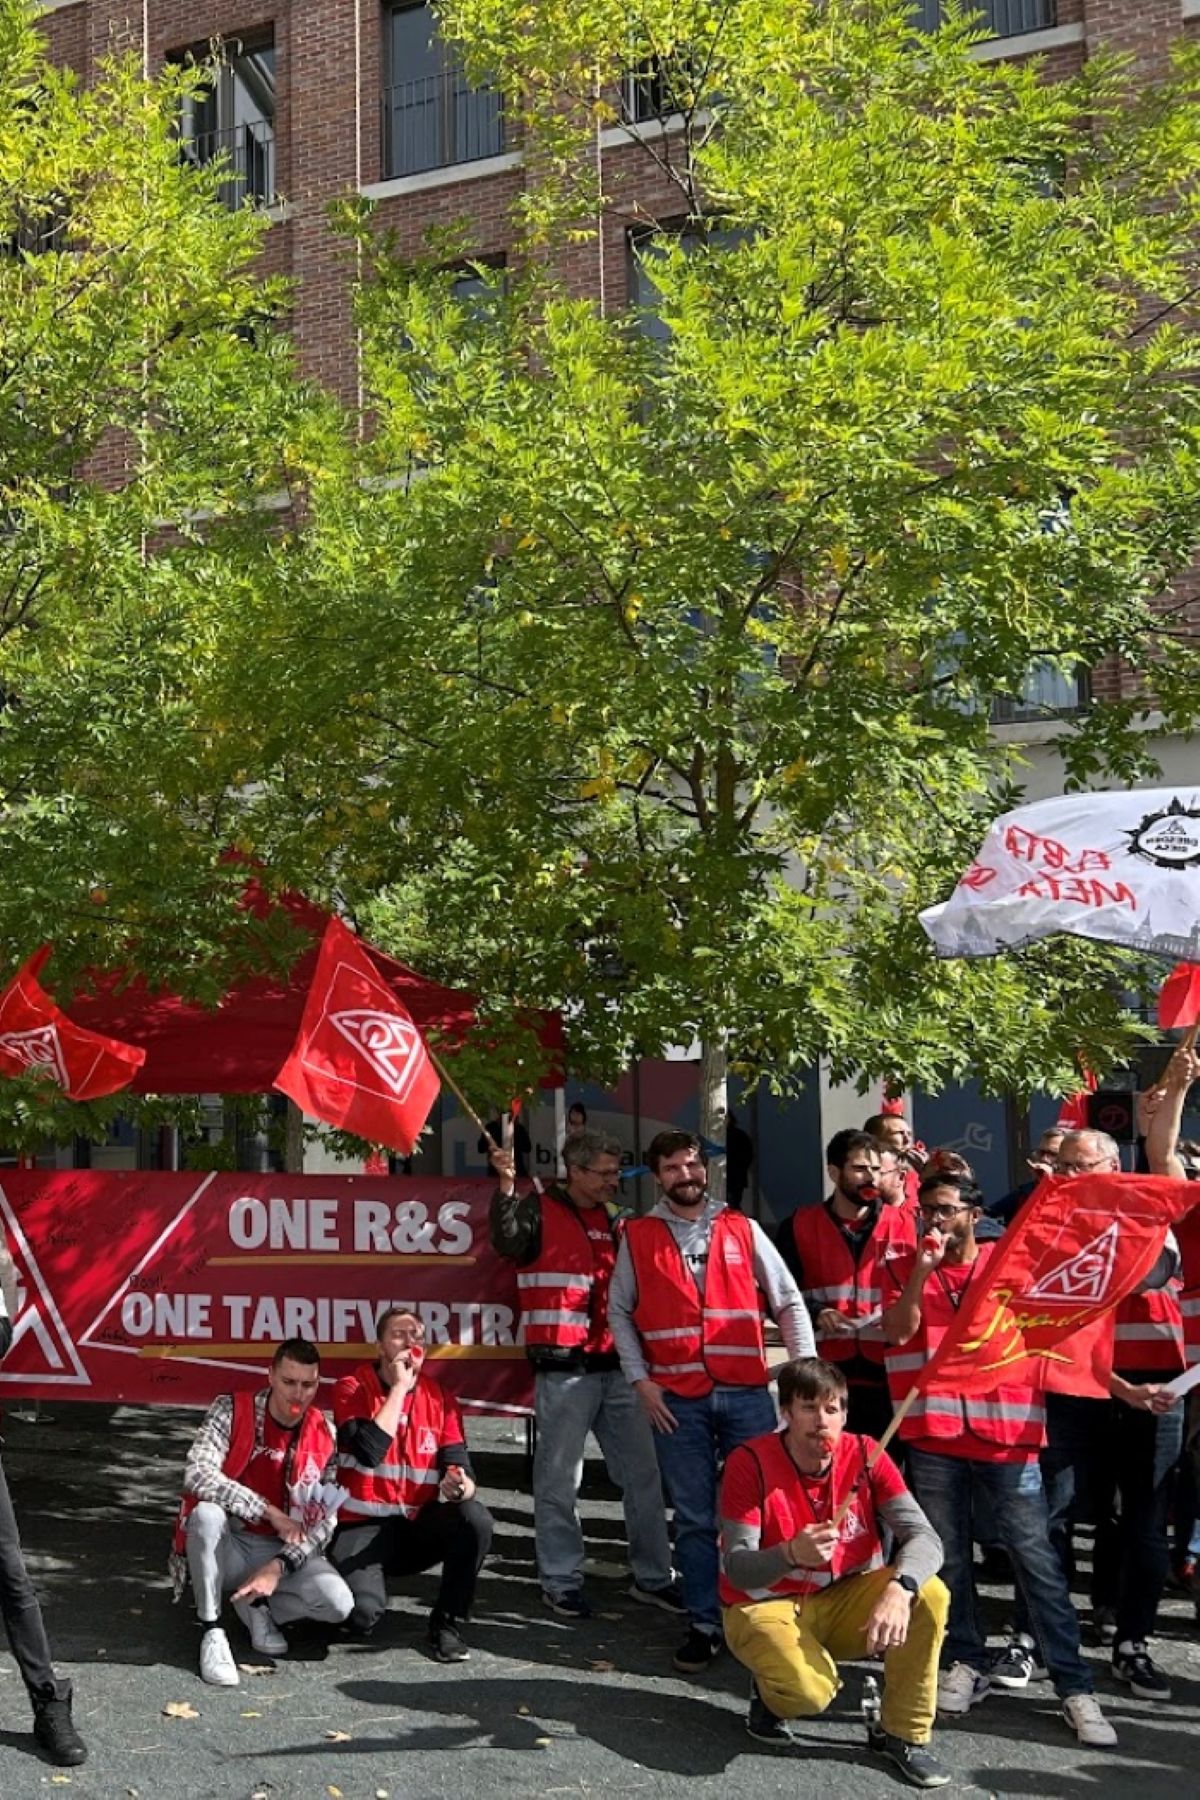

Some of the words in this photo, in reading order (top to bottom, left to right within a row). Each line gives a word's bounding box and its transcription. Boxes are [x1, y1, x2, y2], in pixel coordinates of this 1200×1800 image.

[228, 1197, 340, 1250] ONE
[354, 1200, 474, 1255] R&S
[121, 1292, 213, 1338] ONE
[222, 1295, 526, 1345] TARIFVRTR
